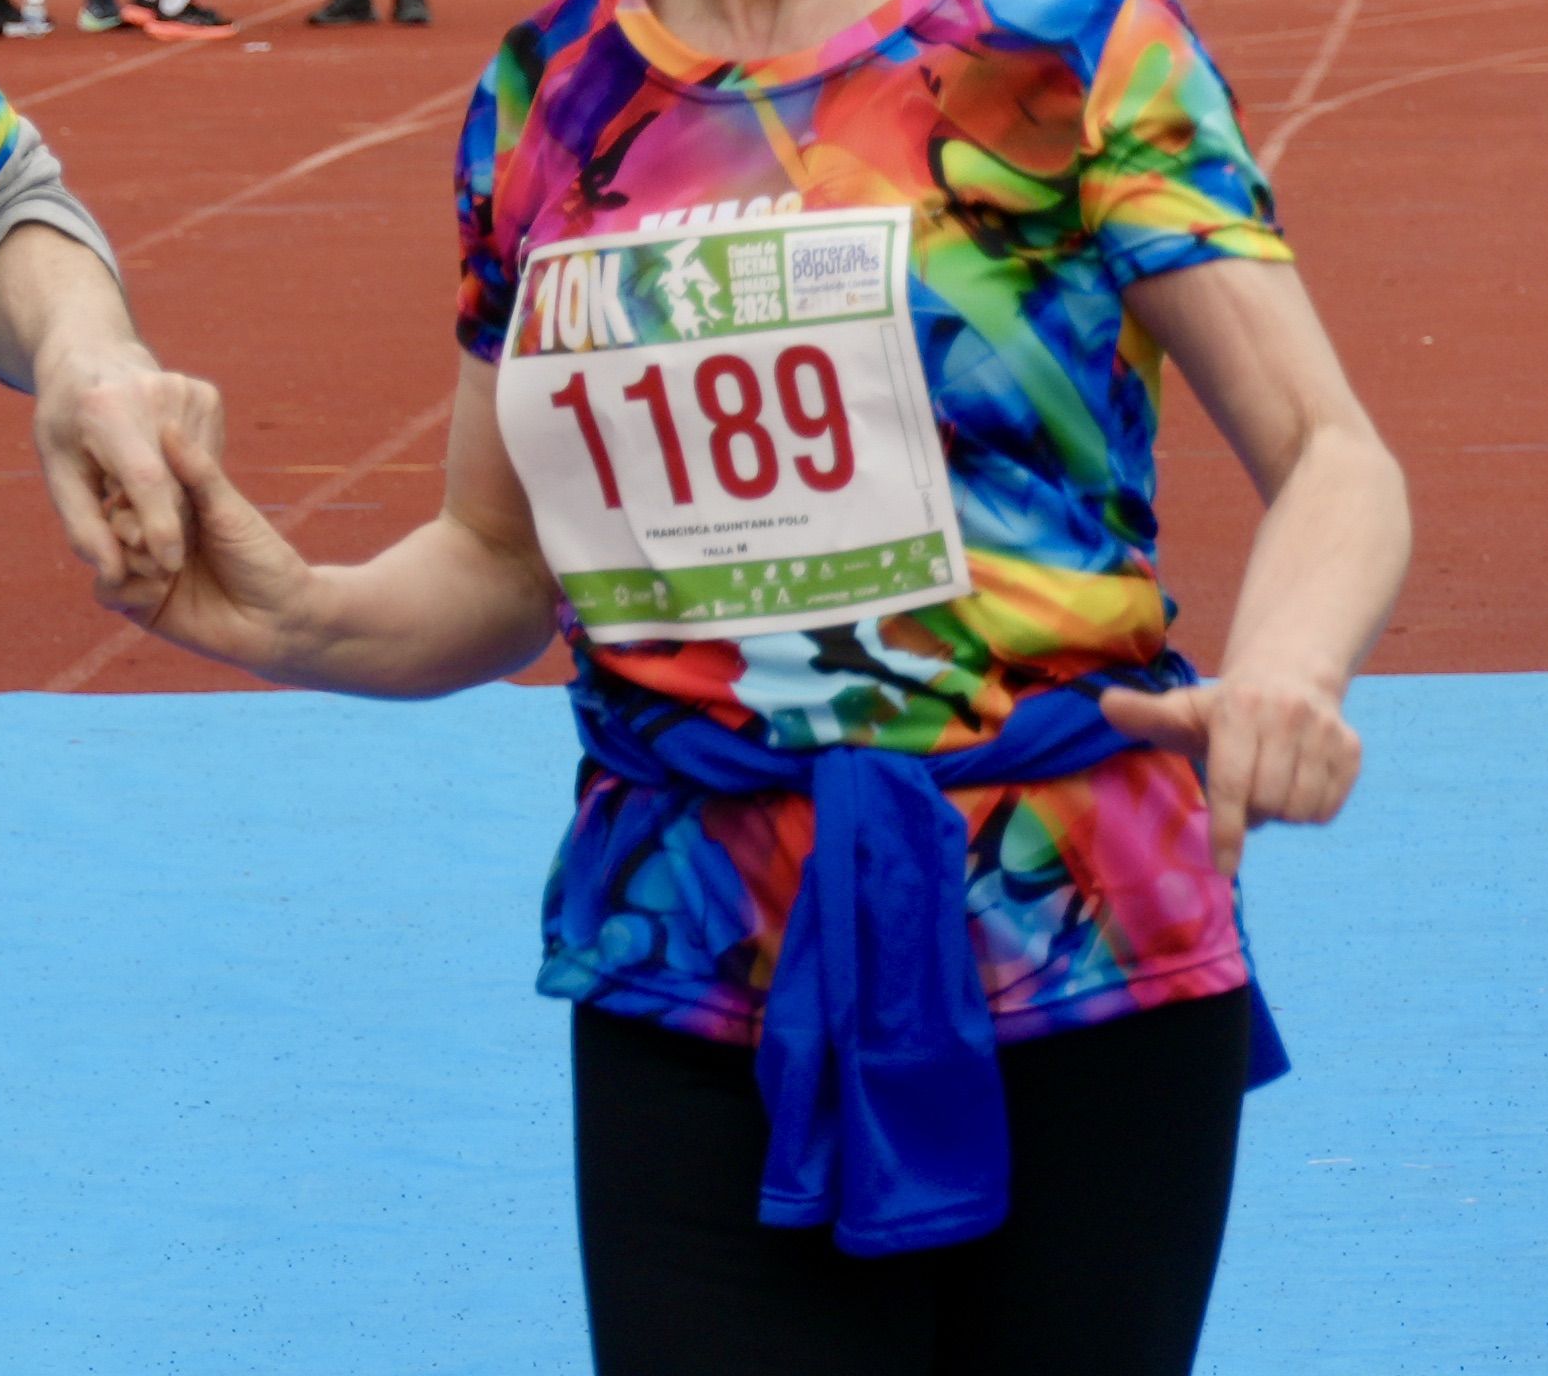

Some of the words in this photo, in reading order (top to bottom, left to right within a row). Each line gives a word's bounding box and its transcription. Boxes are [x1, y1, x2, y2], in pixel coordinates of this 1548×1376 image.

[791, 243, 867, 264] carreras
[792, 254, 880, 284] populares
[533, 251, 638, 354] 10K
[733, 293, 783, 327] 2026
[550, 343, 856, 511] 1189
[713, 517, 776, 534] QUINTANA
[777, 513, 810, 527] POLO
[736, 542, 749, 554] M
